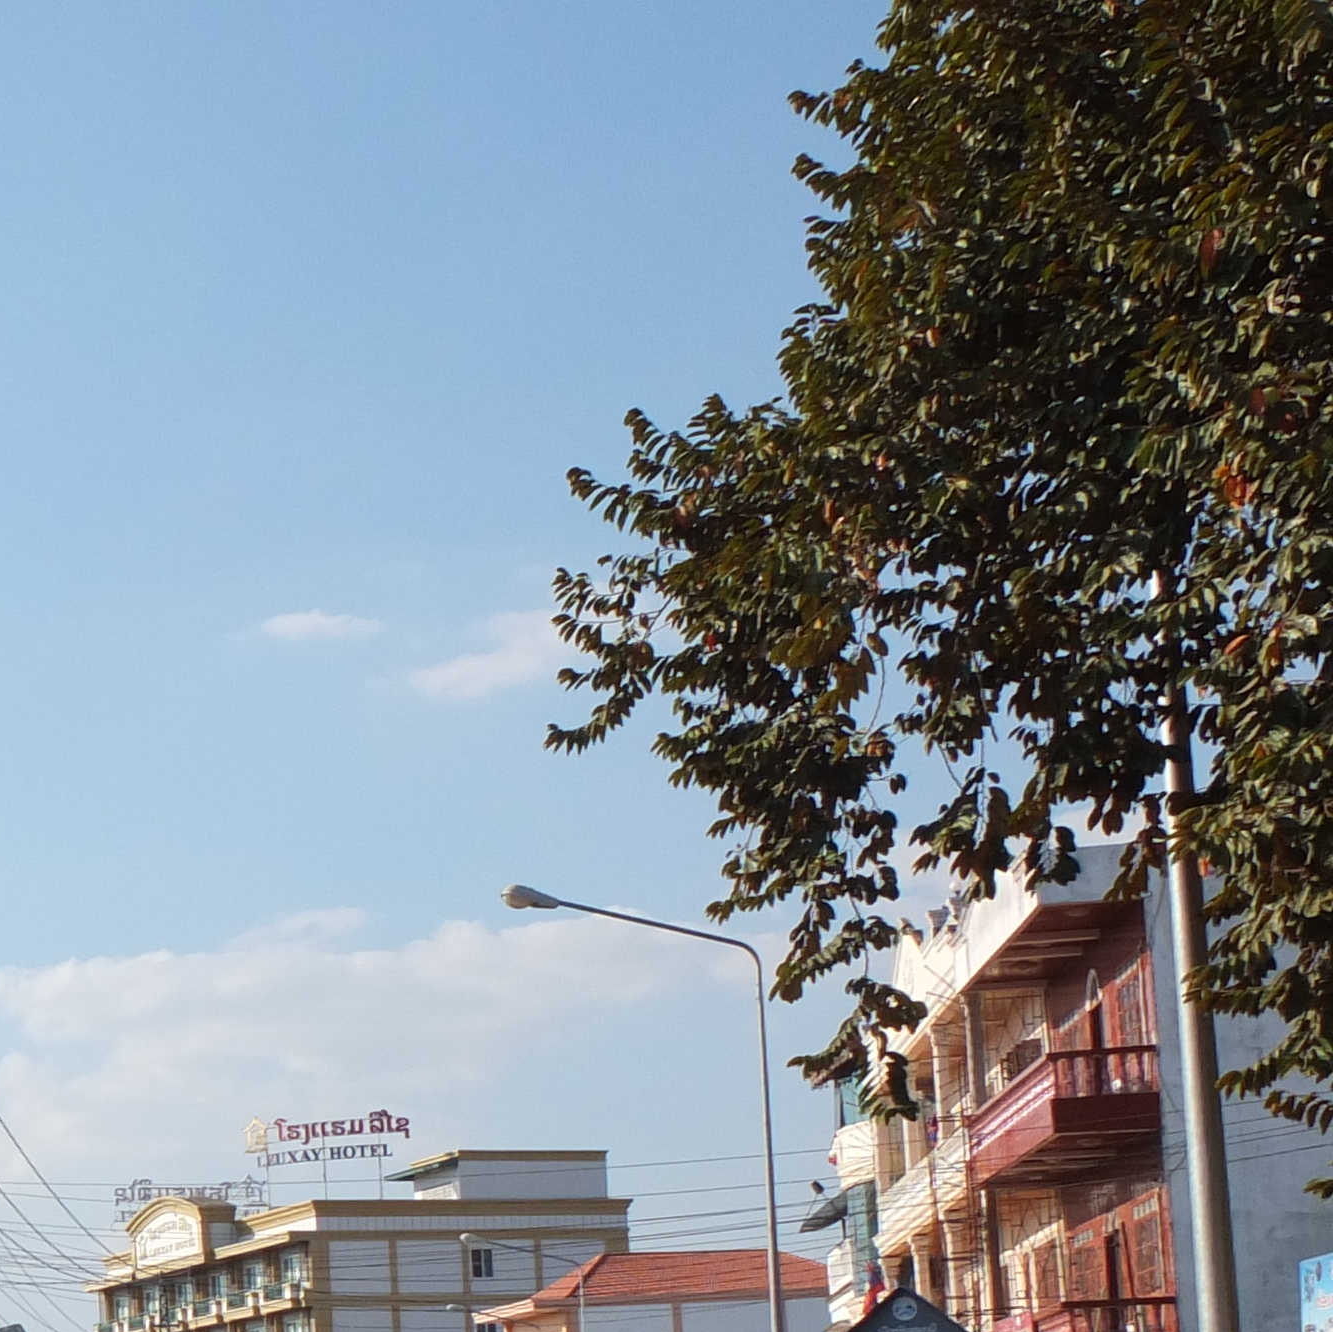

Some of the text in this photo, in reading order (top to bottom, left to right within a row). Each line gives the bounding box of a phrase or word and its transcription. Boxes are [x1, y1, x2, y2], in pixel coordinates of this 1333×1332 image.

[273, 1117, 365, 1145] ໂຮງແຮມ
[256, 1143, 393, 1168] LEUXAY HOTEL
